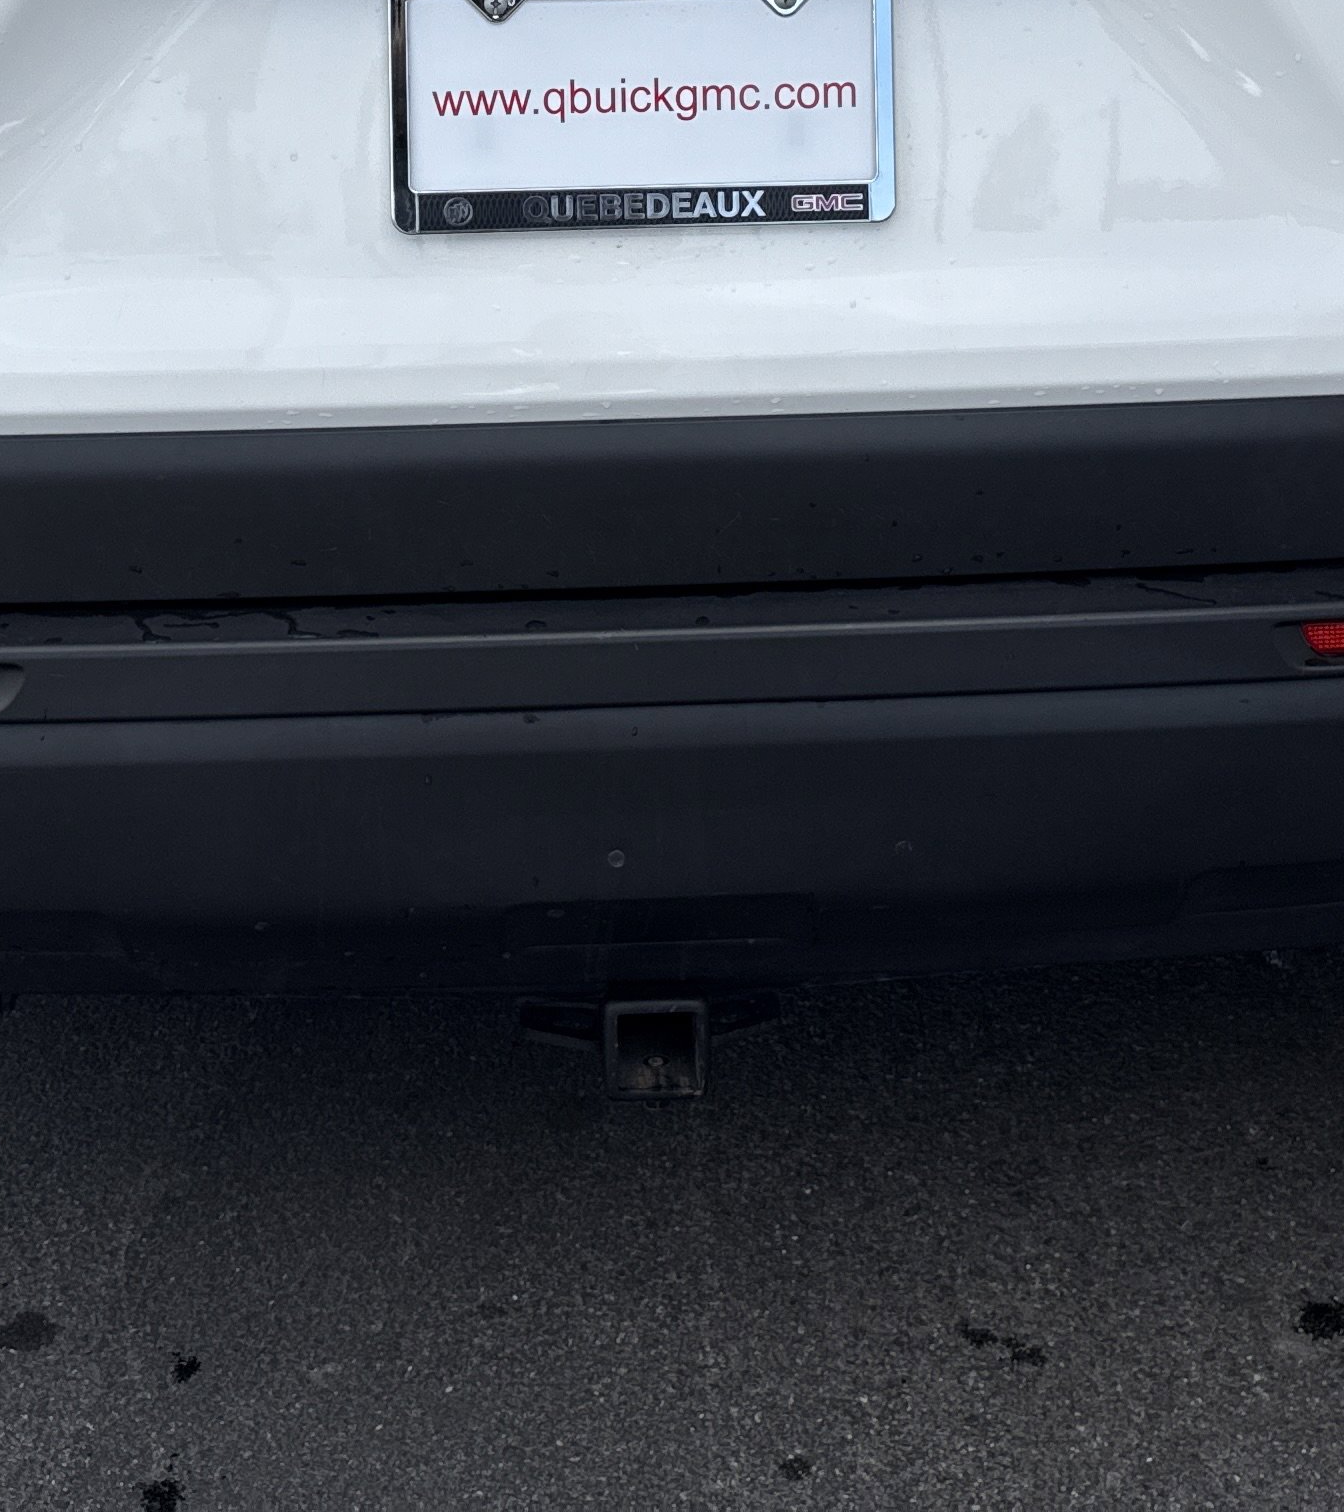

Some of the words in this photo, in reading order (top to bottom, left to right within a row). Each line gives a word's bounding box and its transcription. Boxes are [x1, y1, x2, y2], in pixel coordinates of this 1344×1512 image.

[432, 78, 857, 123] www.qbuickgmc.com
[522, 190, 767, 223] QUEBEDEAUX
[791, 193, 864, 212] GMC
